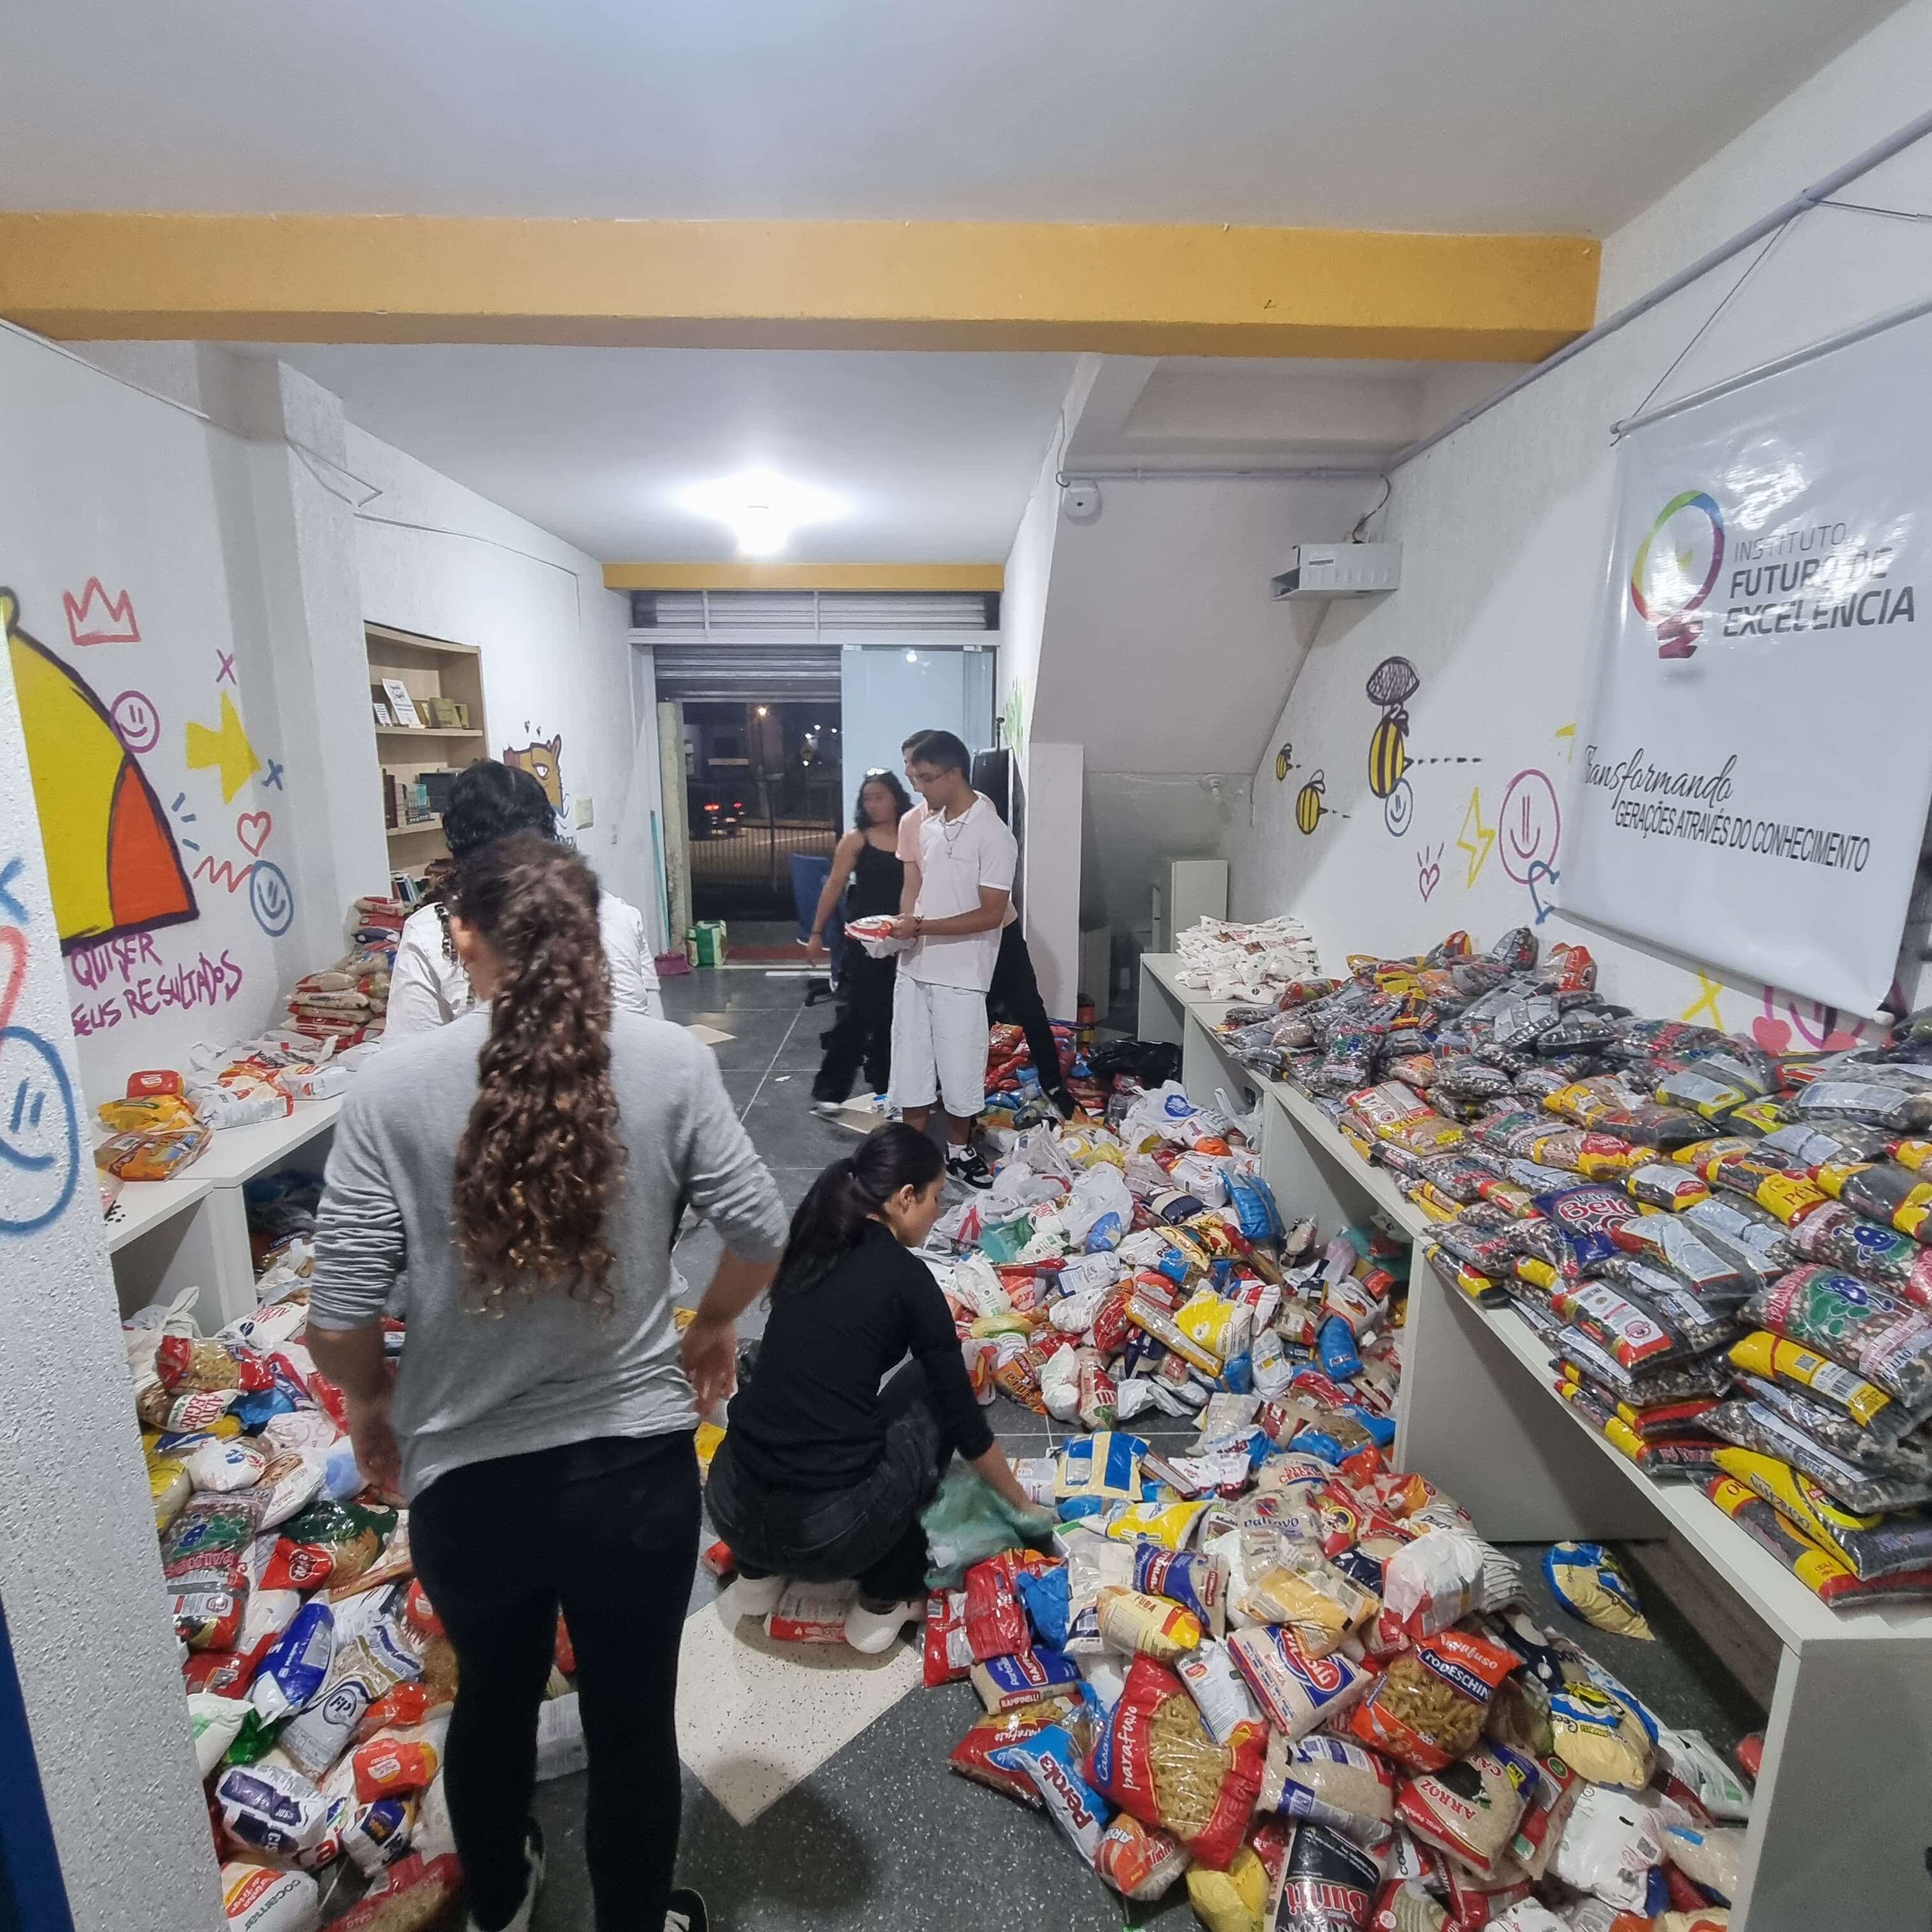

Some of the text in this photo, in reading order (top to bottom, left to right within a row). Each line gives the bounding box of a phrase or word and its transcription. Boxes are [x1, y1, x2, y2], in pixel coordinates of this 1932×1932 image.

[1735, 523, 1846, 562] INSTITUTO
[1585, 745, 1737, 810] Transformando
[1615, 801, 1871, 873] GERAÇÕES ATRAVÉS DO CONHECIMENTO
[71, 933, 163, 991] QUISER
[123, 949, 243, 1019] RESULTADOS
[1425, 1652, 1489, 1701] TODESCHIN
[1039, 1755, 1094, 1830] Pérola
[1420, 1779, 1478, 1822] ARROZ
[245, 1878, 301, 1931] cocamar
